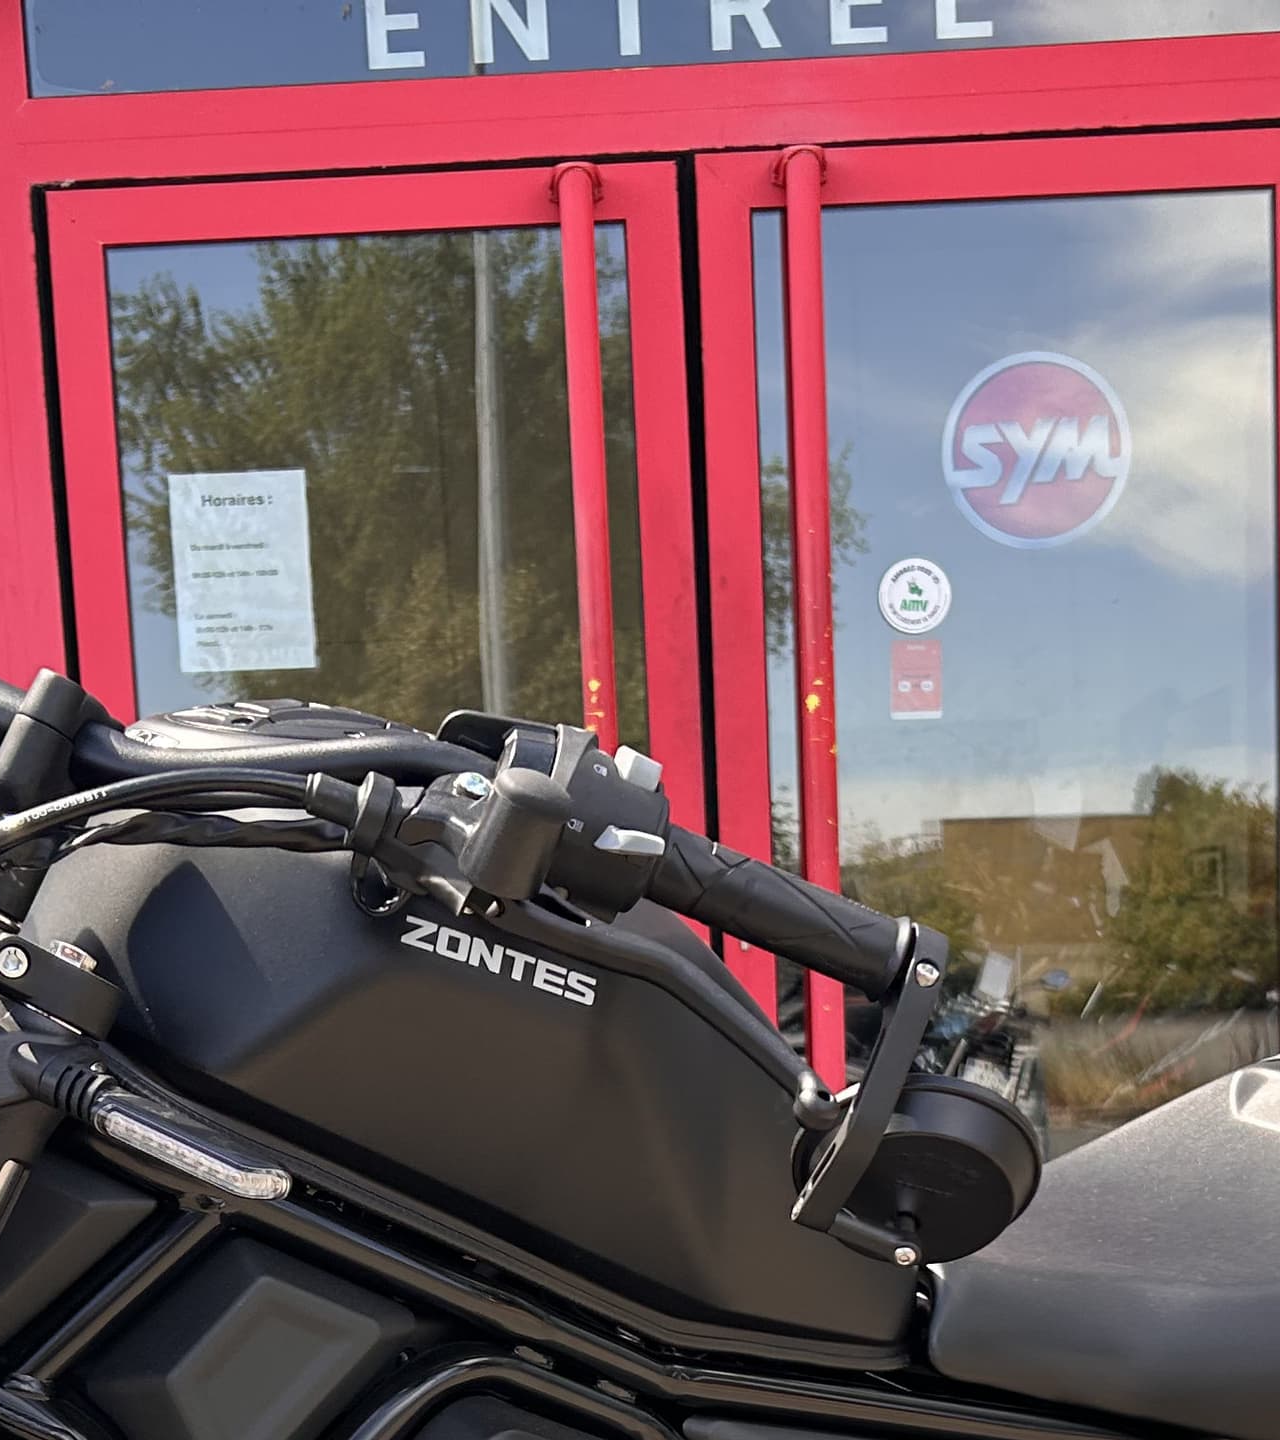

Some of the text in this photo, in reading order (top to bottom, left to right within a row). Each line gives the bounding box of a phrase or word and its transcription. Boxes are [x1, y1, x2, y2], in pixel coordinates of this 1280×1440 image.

[201, 494, 264, 507] Horaires
[952, 414, 1122, 506] SYM
[400, 915, 597, 1006] ZONTES
